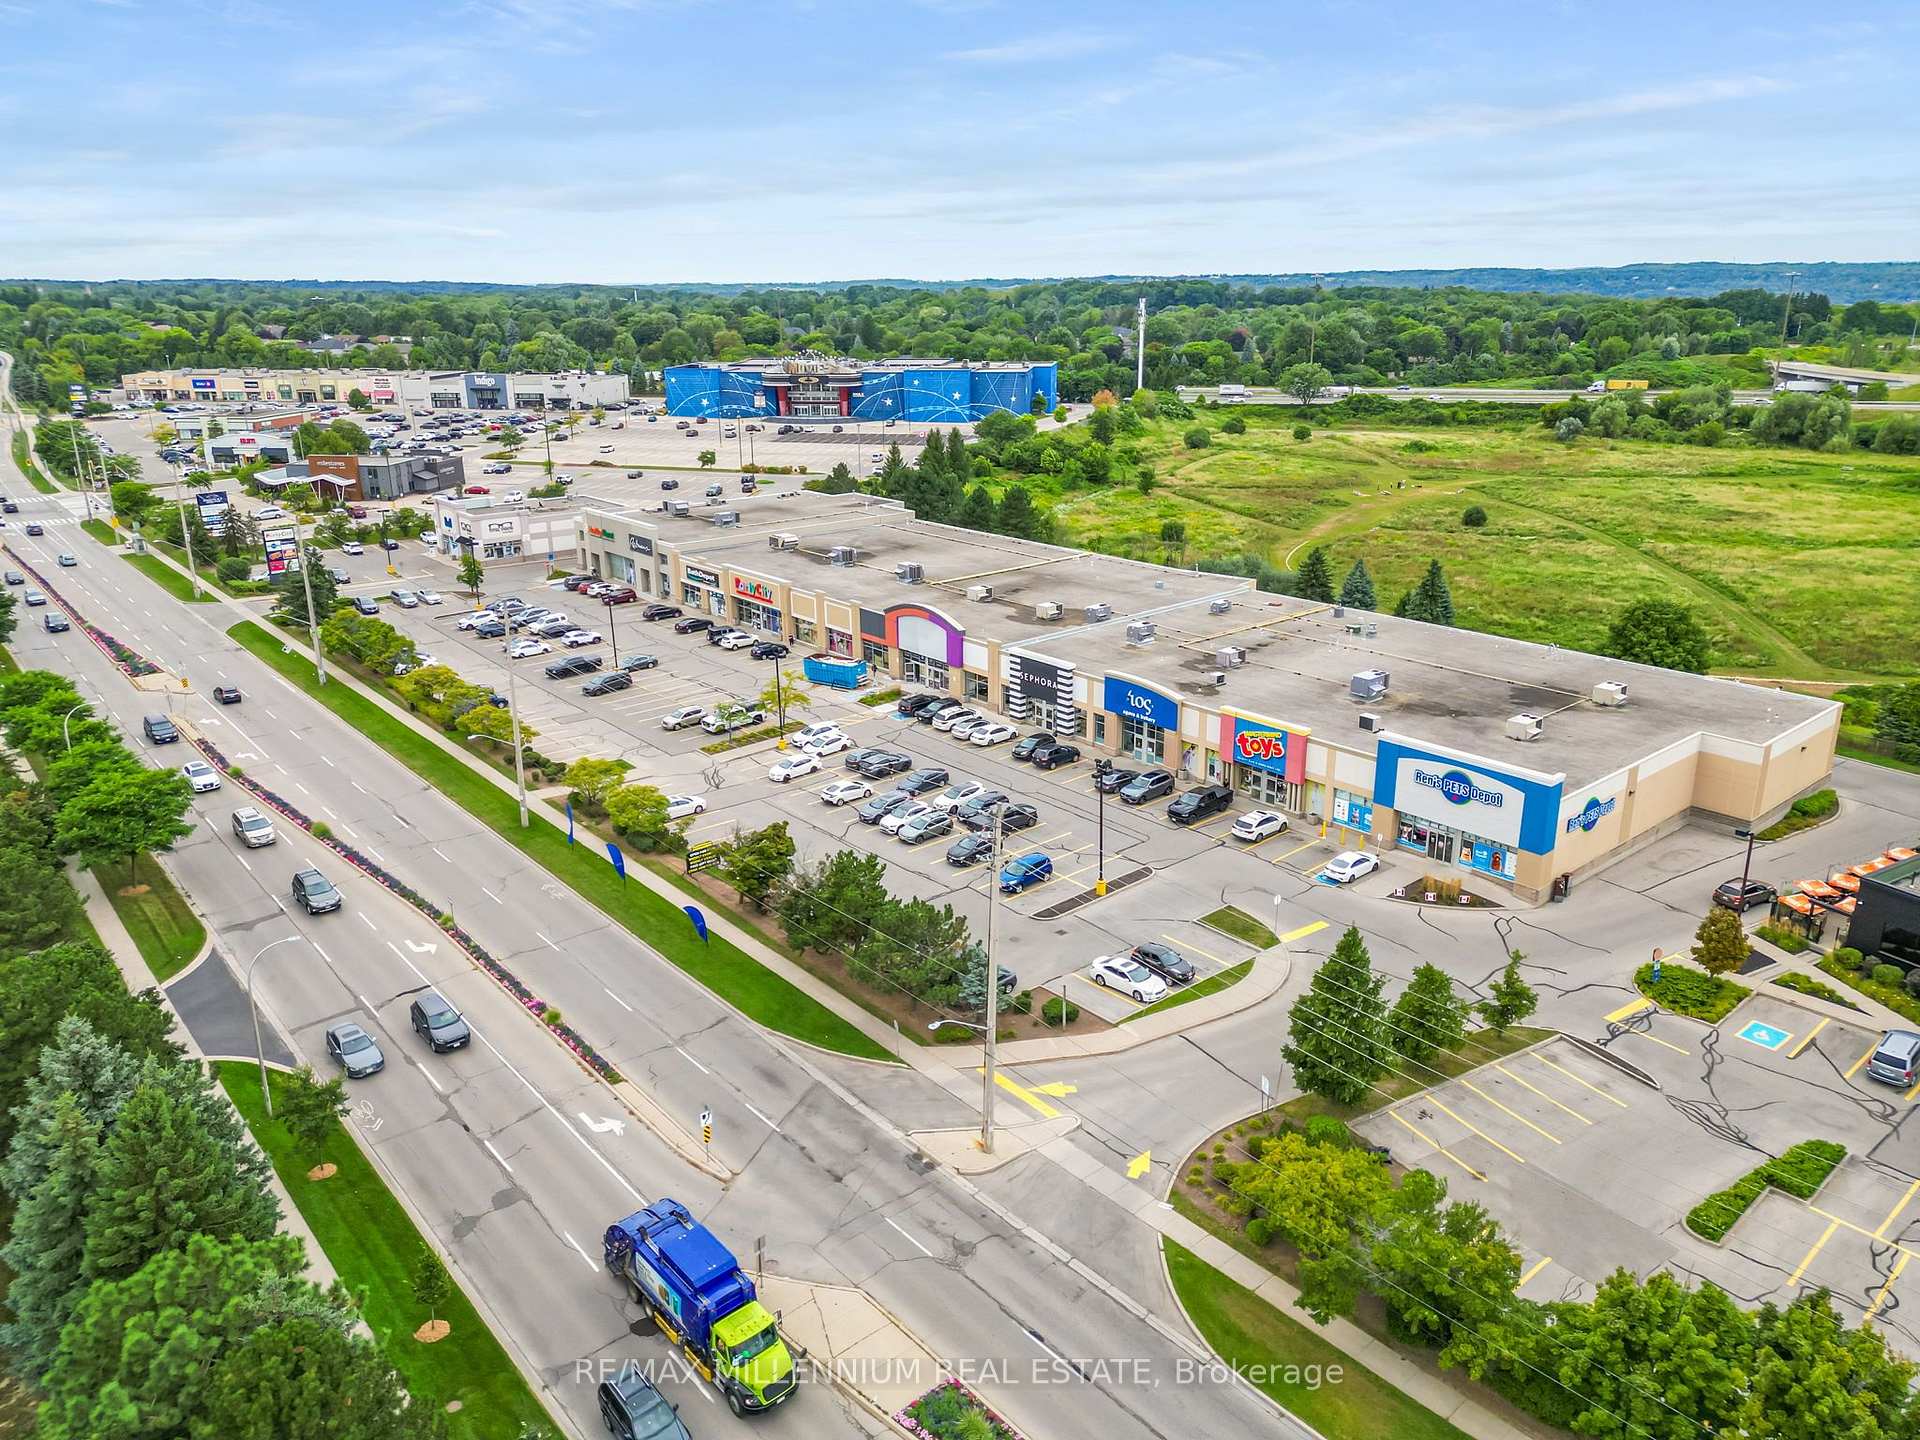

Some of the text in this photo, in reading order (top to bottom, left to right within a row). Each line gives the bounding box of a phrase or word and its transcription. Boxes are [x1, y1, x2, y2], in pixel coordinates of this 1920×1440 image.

[474, 375, 495, 386] Indigo
[1020, 671, 1058, 689] SEPHORA
[1236, 731, 1284, 760] toys
[1414, 769, 1503, 808] Ren's PETS Depot
